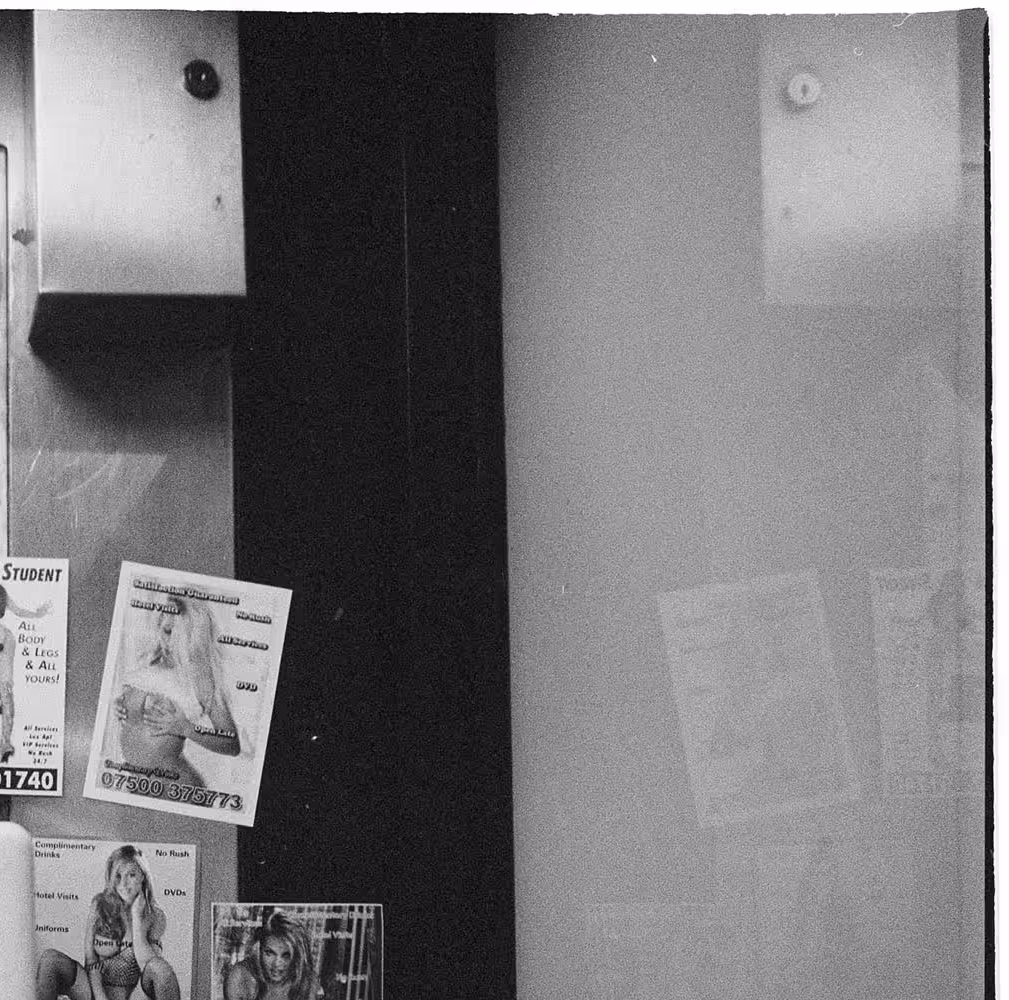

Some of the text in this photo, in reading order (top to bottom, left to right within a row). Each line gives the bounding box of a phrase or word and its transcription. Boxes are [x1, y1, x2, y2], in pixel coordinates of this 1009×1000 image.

[2, 563, 63, 583] STUDENT
[21, 647, 60, 657] & LEGS
[25, 660, 33, 670] &
[194, 724, 236, 739] Open Late
[101, 771, 244, 811] 07500 375773
[35, 841, 96, 852] Complimentary
[34, 851, 61, 859] Drinks
[155, 849, 190, 858] No Rush
[57, 892, 79, 901] Visits
[163, 889, 187, 897] DVDs
[93, 939, 114, 948] Open
